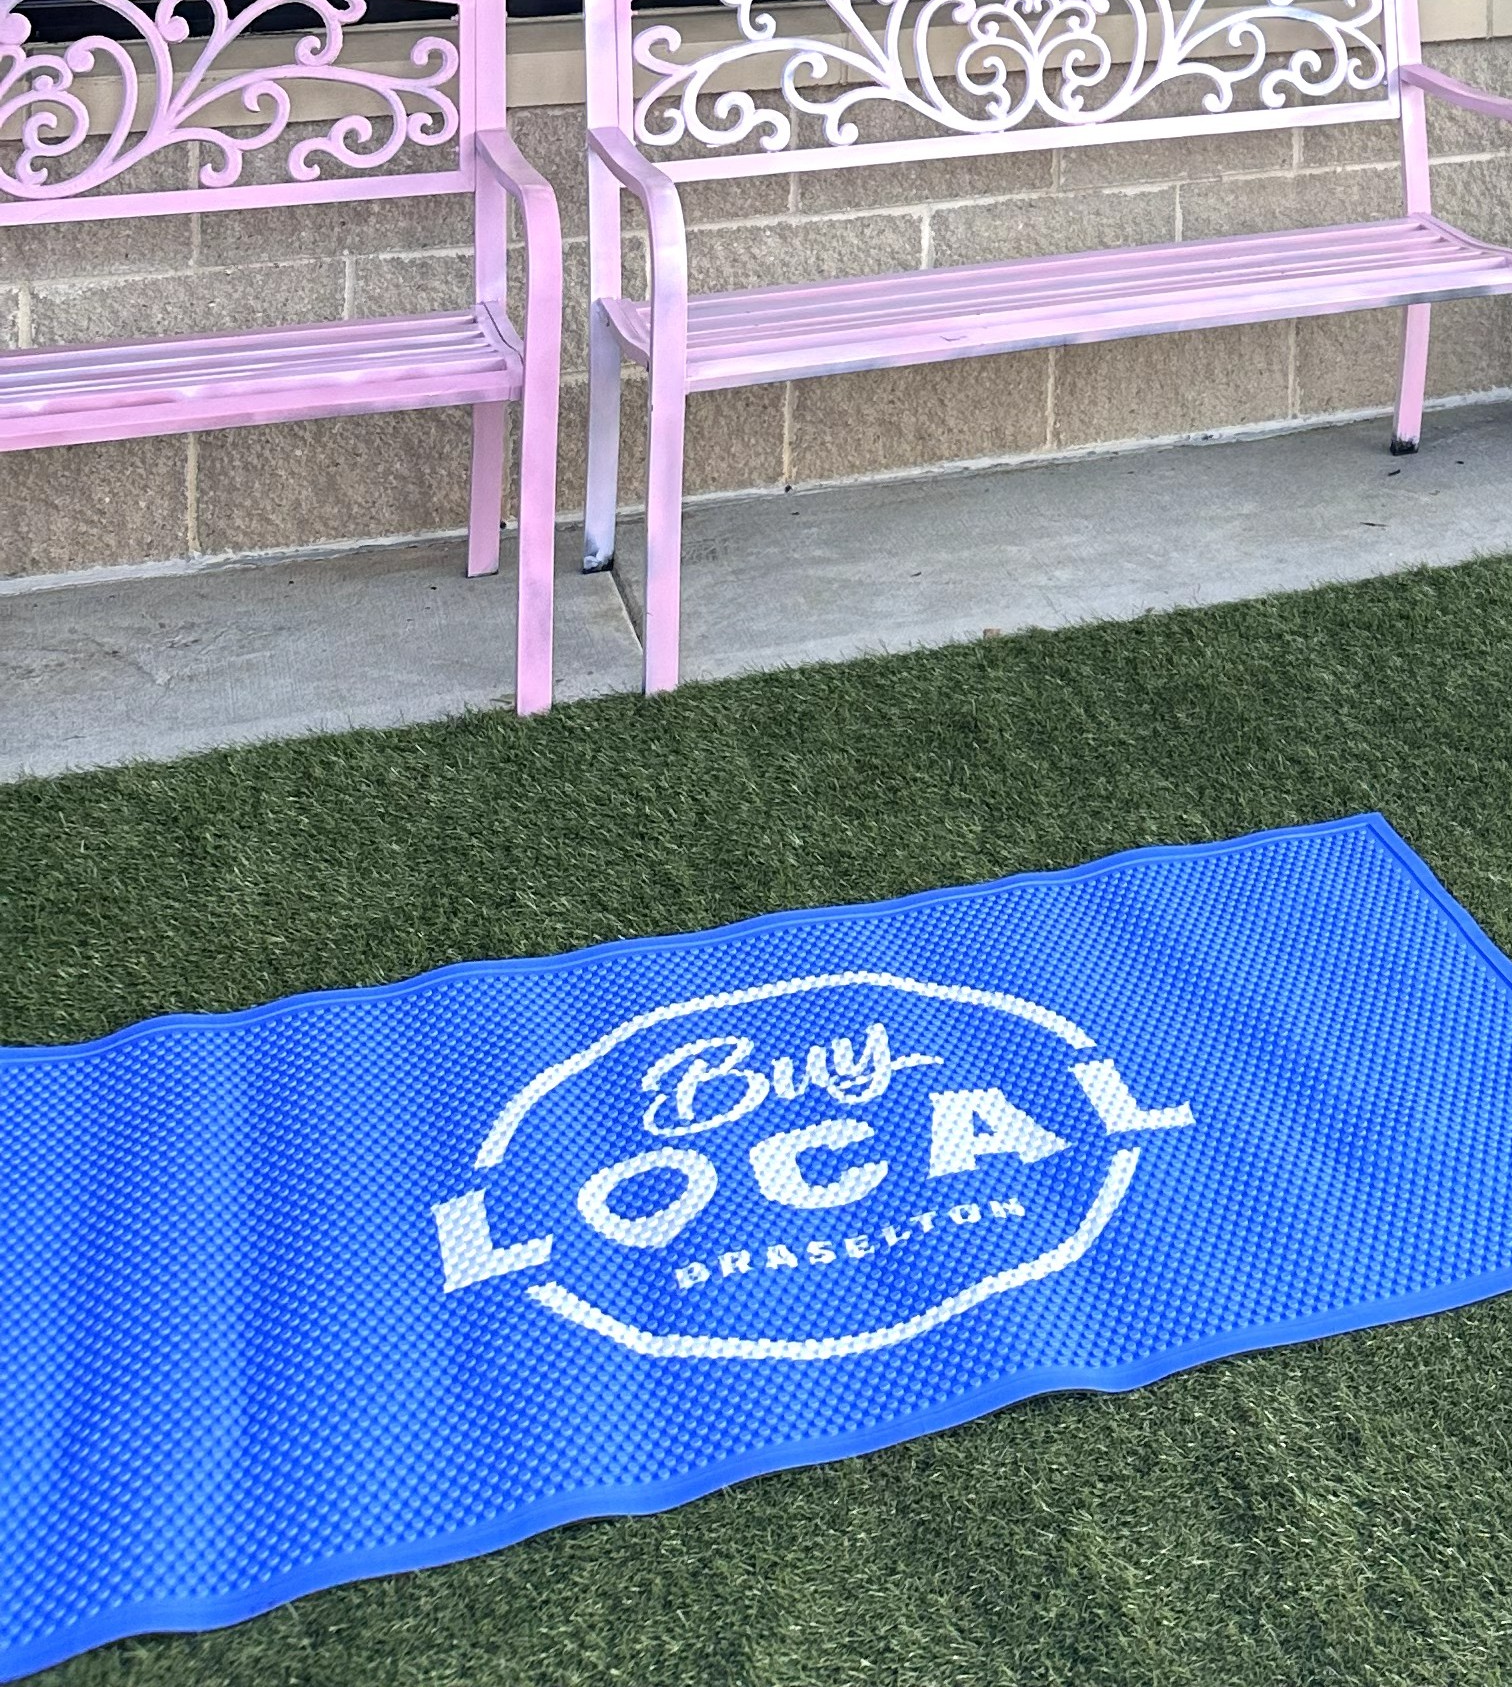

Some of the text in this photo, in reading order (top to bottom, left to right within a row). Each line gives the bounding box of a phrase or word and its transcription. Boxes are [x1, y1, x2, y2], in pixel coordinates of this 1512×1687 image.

[641, 1022, 945, 1137] Buy
[430, 1057, 1197, 1294] LOCAL
[675, 1196, 1027, 1290] BRASELTON
